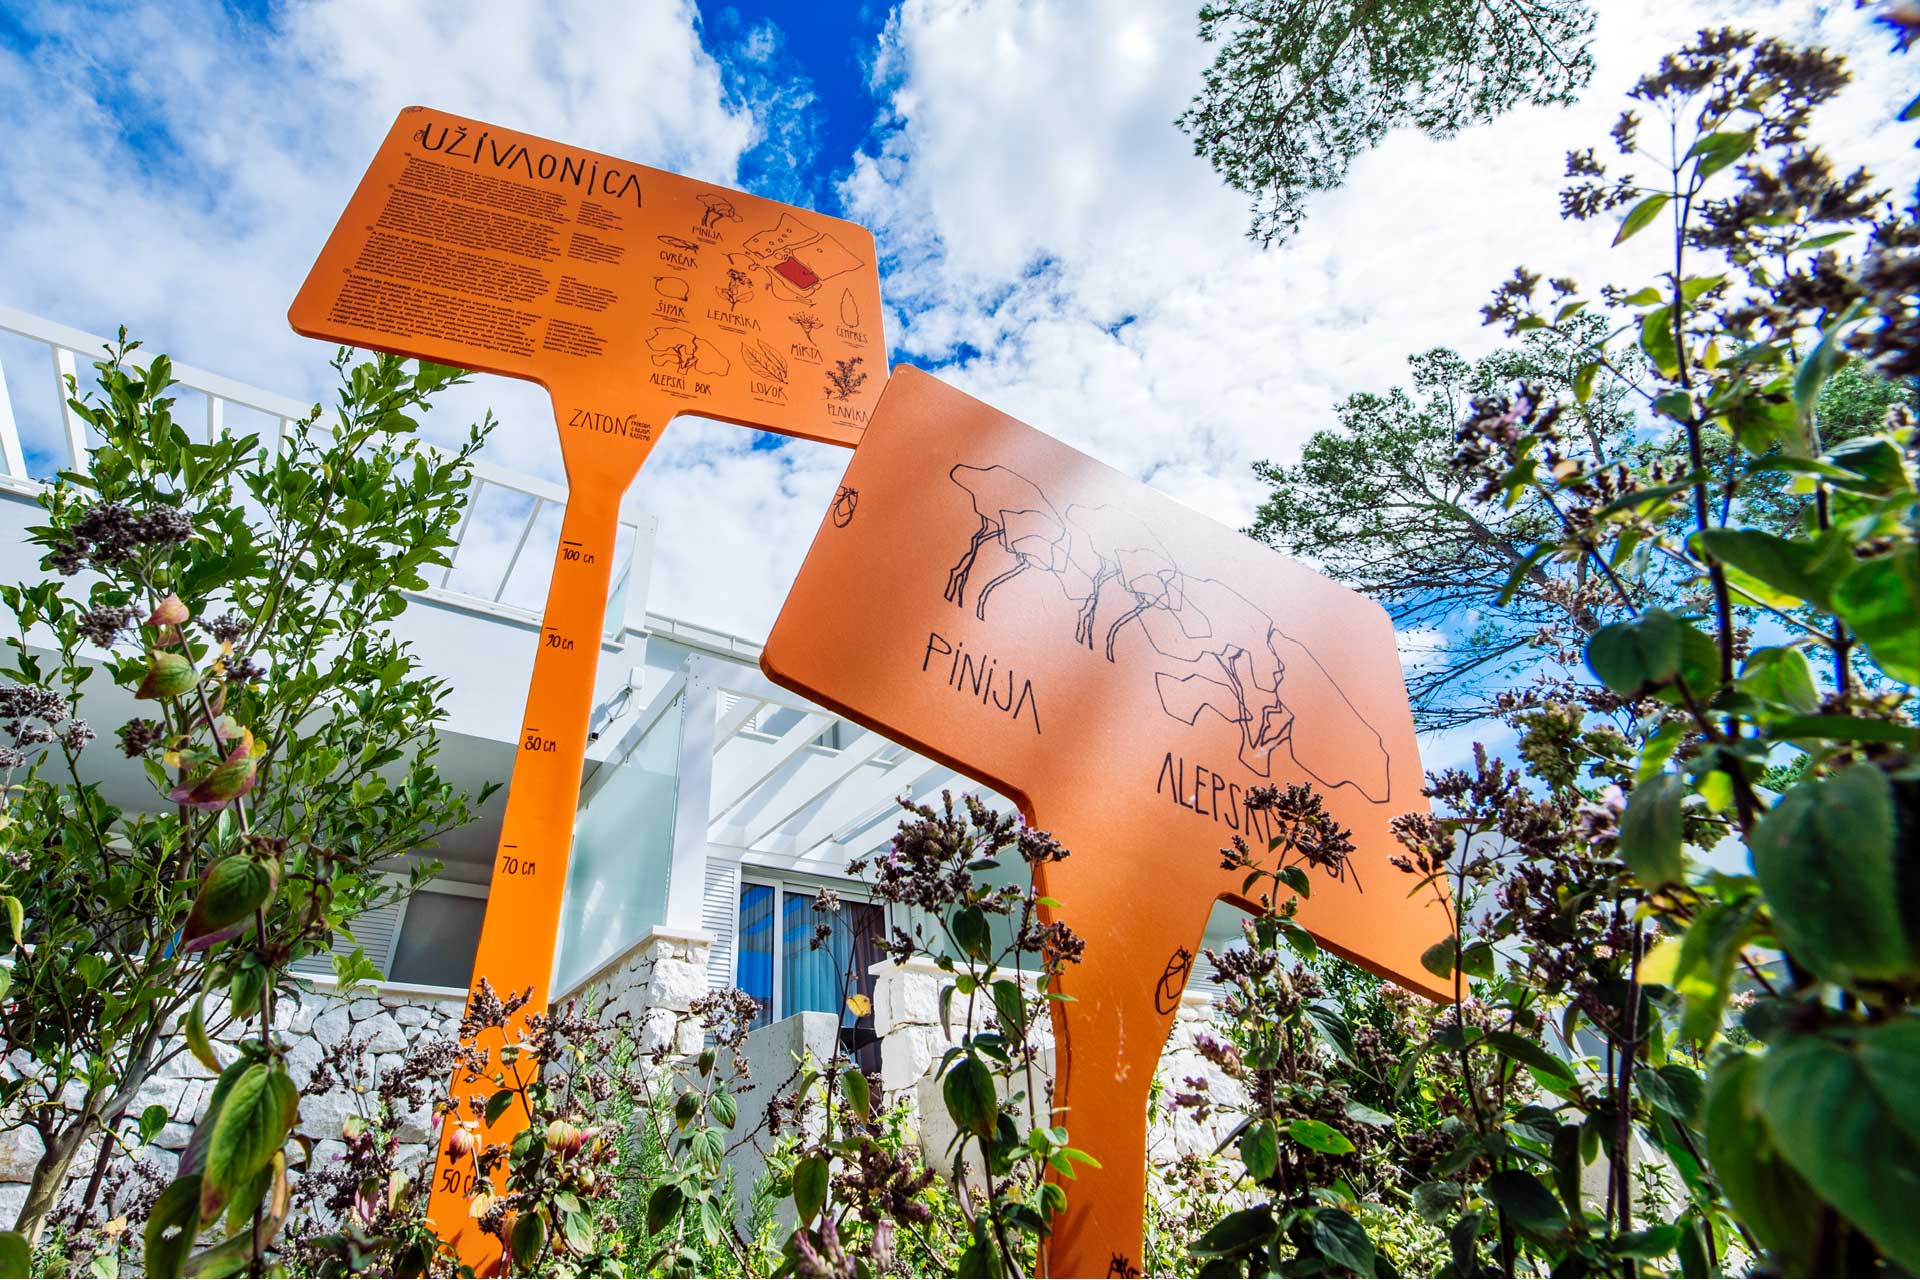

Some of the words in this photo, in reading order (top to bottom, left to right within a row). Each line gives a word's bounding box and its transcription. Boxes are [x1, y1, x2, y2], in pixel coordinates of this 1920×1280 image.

[421, 123, 642, 208] UŽIVAONICA
[692, 225, 723, 242] PINIJA
[790, 343, 823, 363] MIRTA
[694, 382, 712, 396] BOR
[750, 380, 788, 401] LOVOR
[569, 408, 629, 437] ZATON
[562, 547, 581, 562] 100
[922, 631, 1042, 736] PINIJA
[524, 735, 542, 752] 80
[502, 855, 519, 875] 70
[440, 1169, 461, 1194] 50
